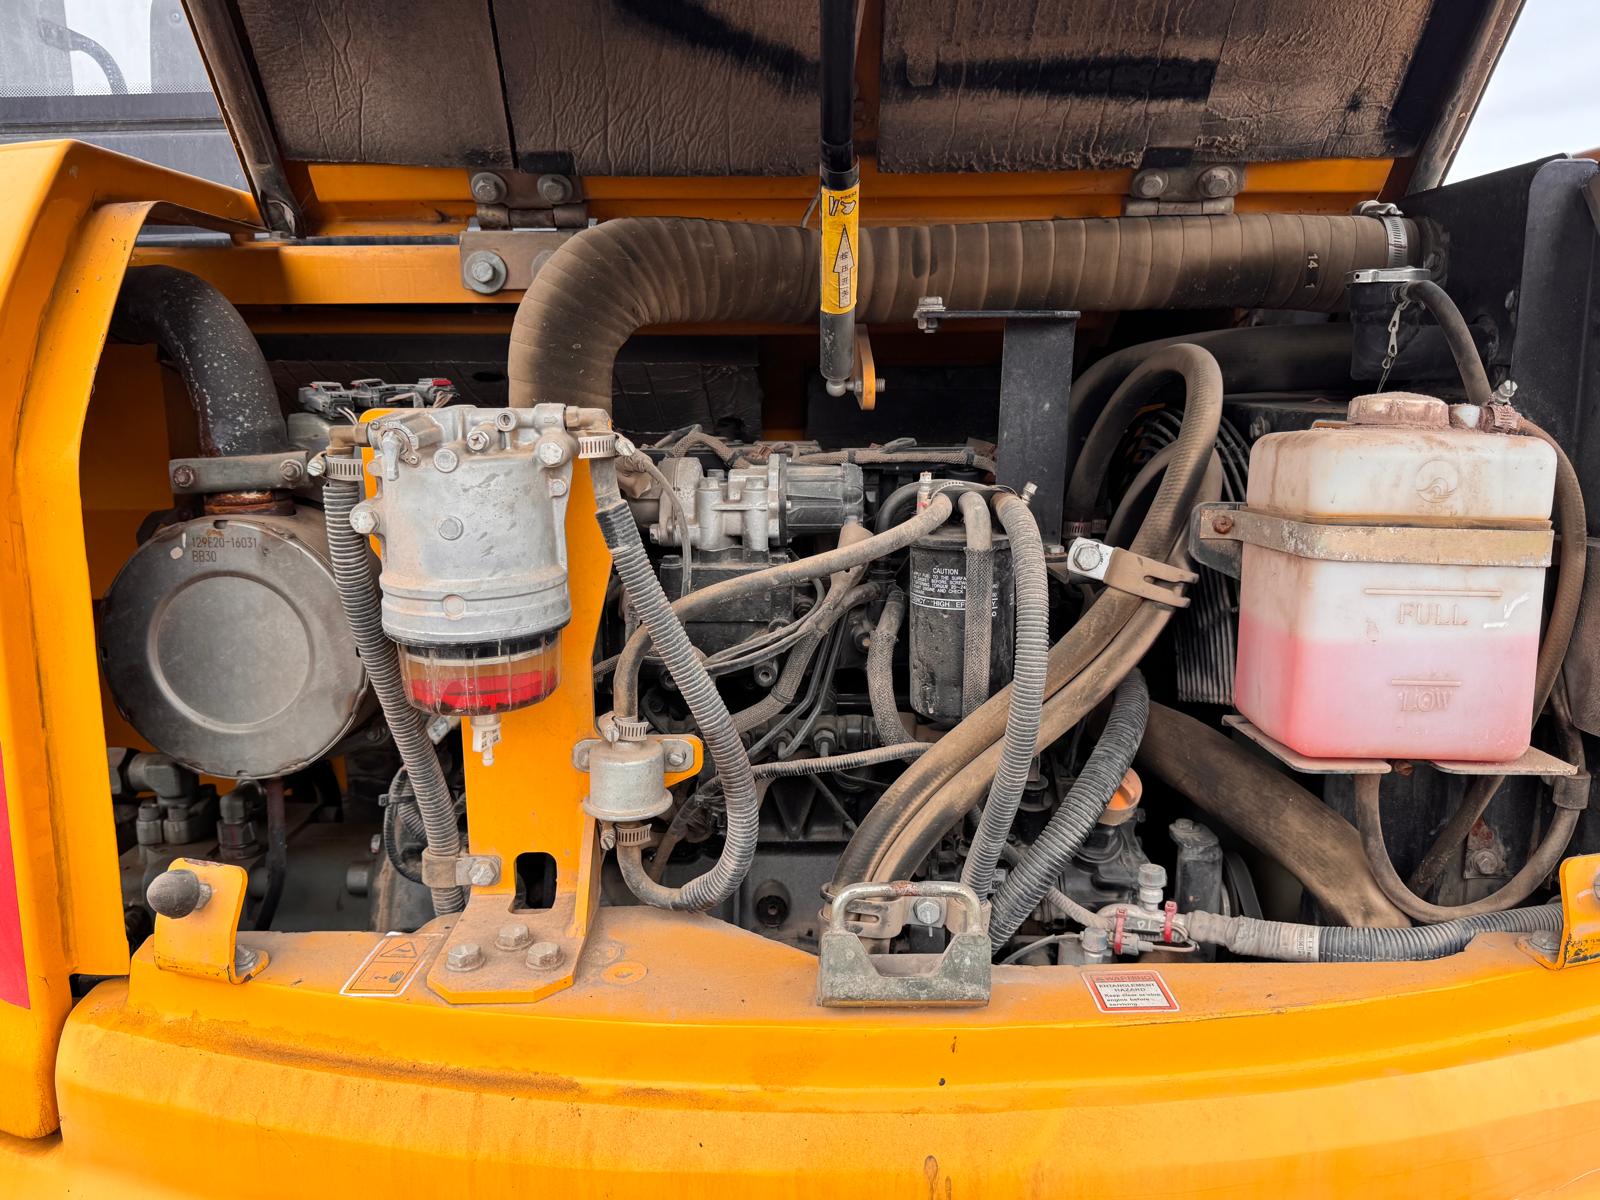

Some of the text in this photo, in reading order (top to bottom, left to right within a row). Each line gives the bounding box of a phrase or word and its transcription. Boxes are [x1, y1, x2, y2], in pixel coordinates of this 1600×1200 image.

[192, 550, 217, 562] BB30
[932, 567, 959, 575] CAUTION
[933, 600, 950, 608] HIGH
[1399, 603, 1468, 625] FULL
[1400, 690, 1453, 712] LOW
